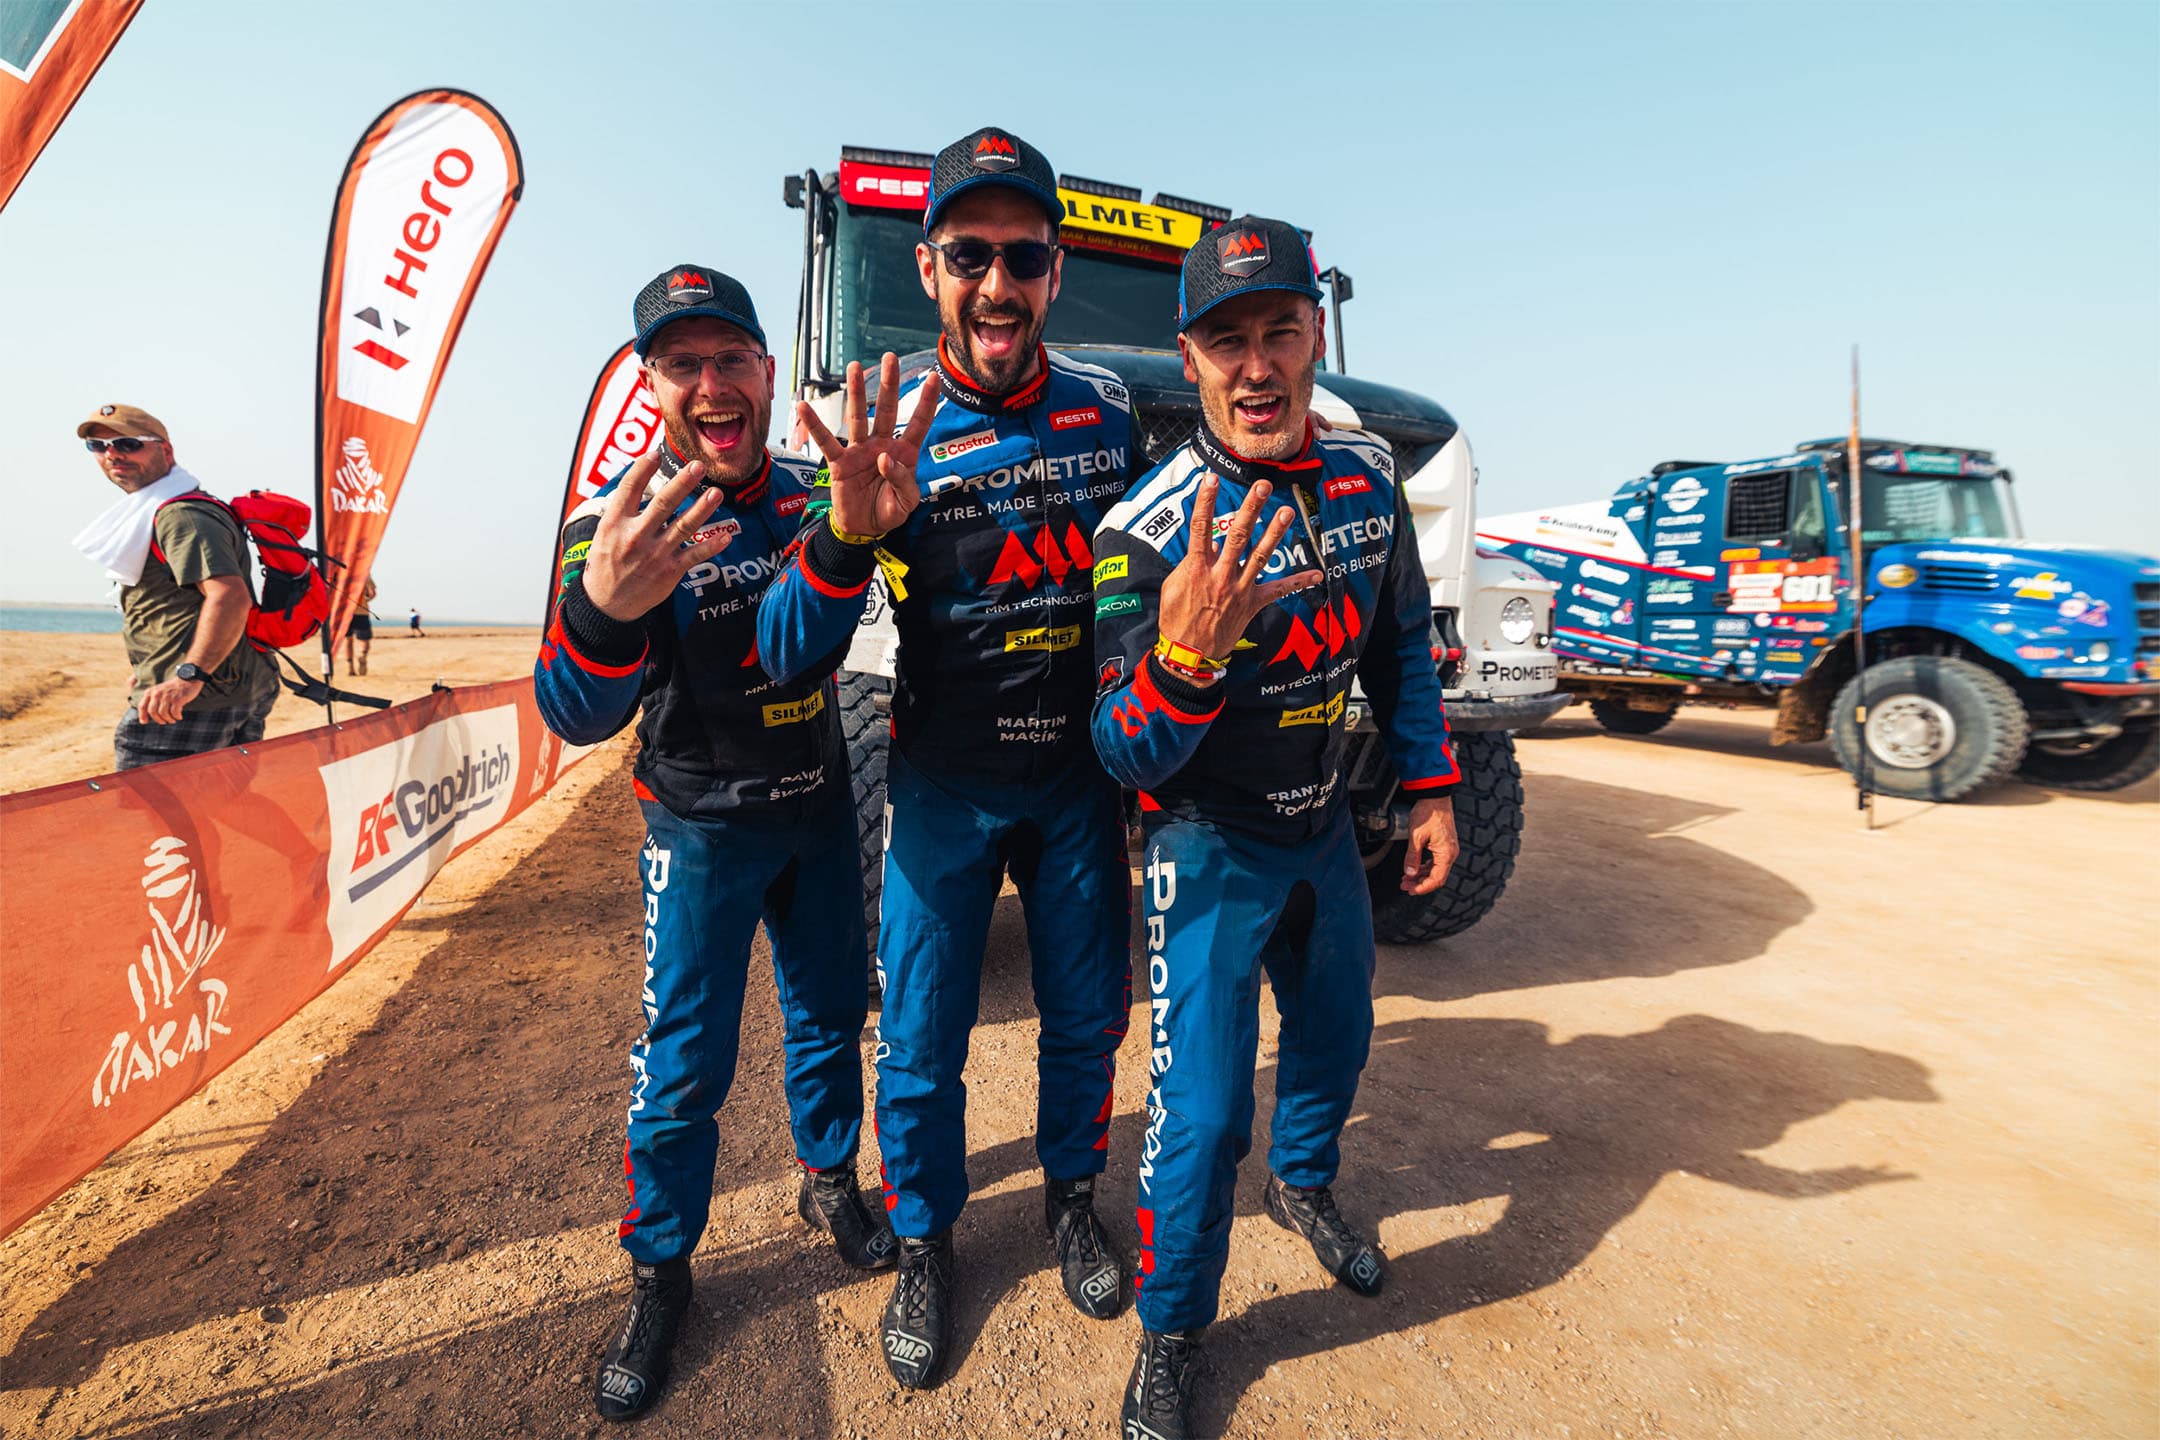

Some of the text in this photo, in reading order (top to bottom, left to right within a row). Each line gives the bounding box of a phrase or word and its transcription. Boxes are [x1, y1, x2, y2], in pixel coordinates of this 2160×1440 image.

[856, 176, 930, 197] FES
[384, 148, 474, 299] Hero
[1067, 199, 1177, 235] LMET
[1103, 384, 1128, 400] OMP
[1056, 412, 1096, 426] FESTA
[948, 434, 996, 456] Castrol
[925, 447, 1126, 503] PROMETEON
[780, 497, 808, 512] FESTA
[931, 480, 1126, 524] TYRE. MADE FOR BUSINESS
[692, 522, 738, 543] Castrol
[1146, 509, 1176, 538] OMP
[1327, 547, 1388, 579] FOR BUSINE
[699, 599, 744, 621] TYRE.
[985, 604, 1010, 615] MM
[1015, 632, 1074, 647] SILMET
[1261, 684, 1286, 696] MM
[997, 715, 1067, 729] MARTIN
[351, 744, 511, 873] BFGoodrich
[92, 977, 232, 1107] DAKAR
